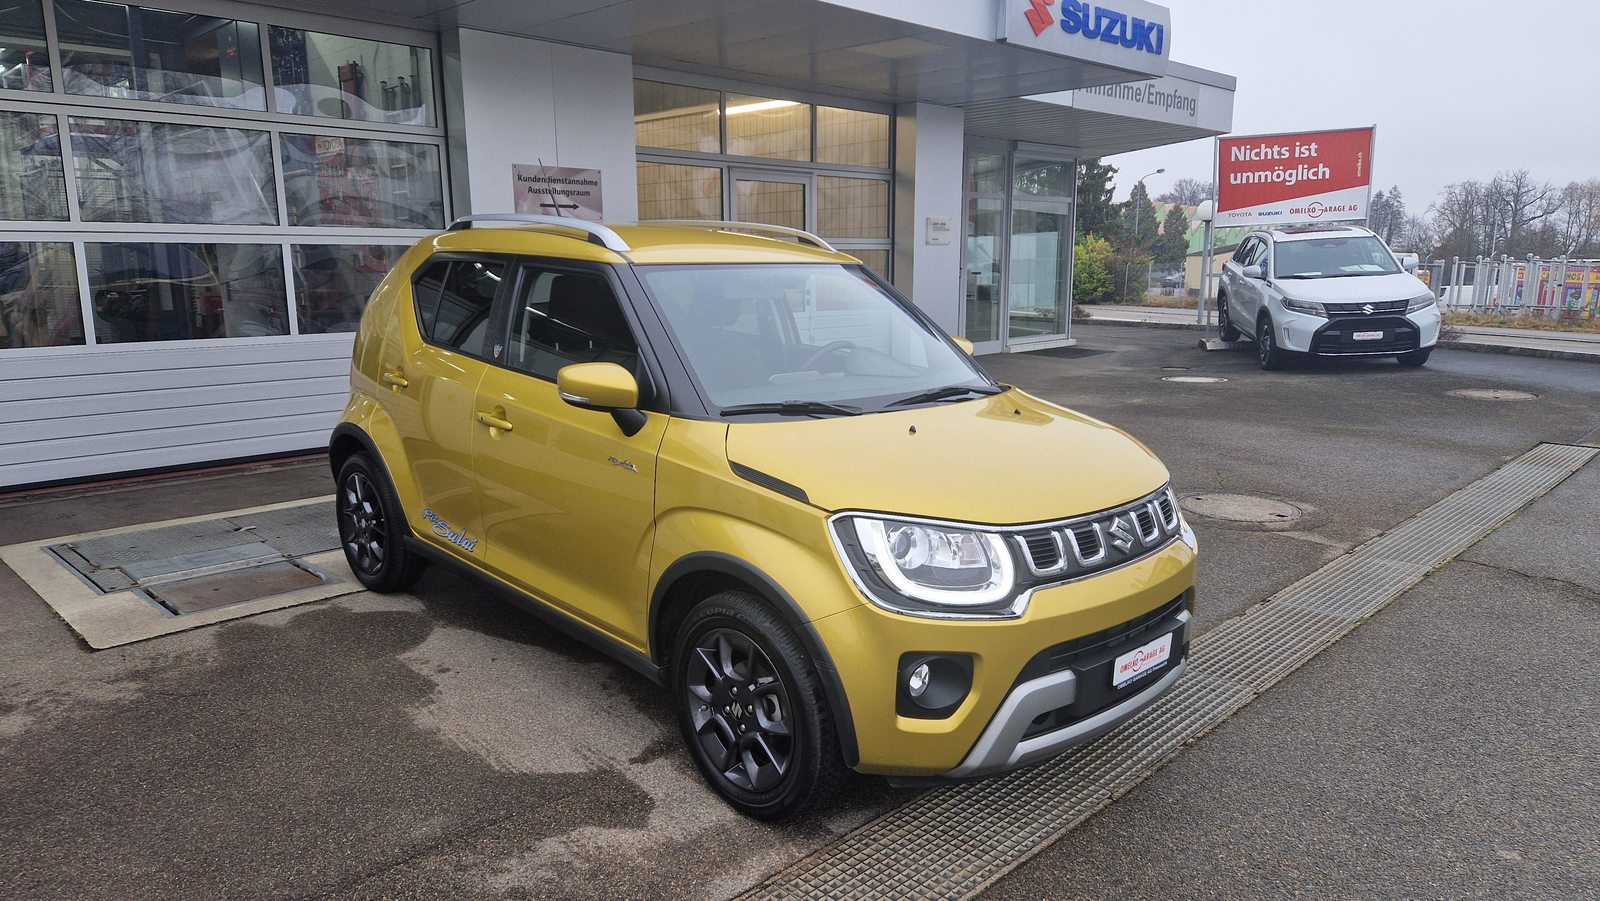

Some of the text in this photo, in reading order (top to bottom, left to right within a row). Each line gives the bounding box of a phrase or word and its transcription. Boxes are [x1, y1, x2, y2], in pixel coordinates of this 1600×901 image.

[1060, 0, 1164, 55] SUZUKI
[1231, 142, 1318, 161] Nichts ist
[517, 174, 598, 187] Kundendienstannahme
[1230, 163, 1330, 186] unmöglich
[1289, 206, 1317, 215] OMELKO
[1348, 204, 1358, 212] AG
[431, 519, 478, 552] Sulai
